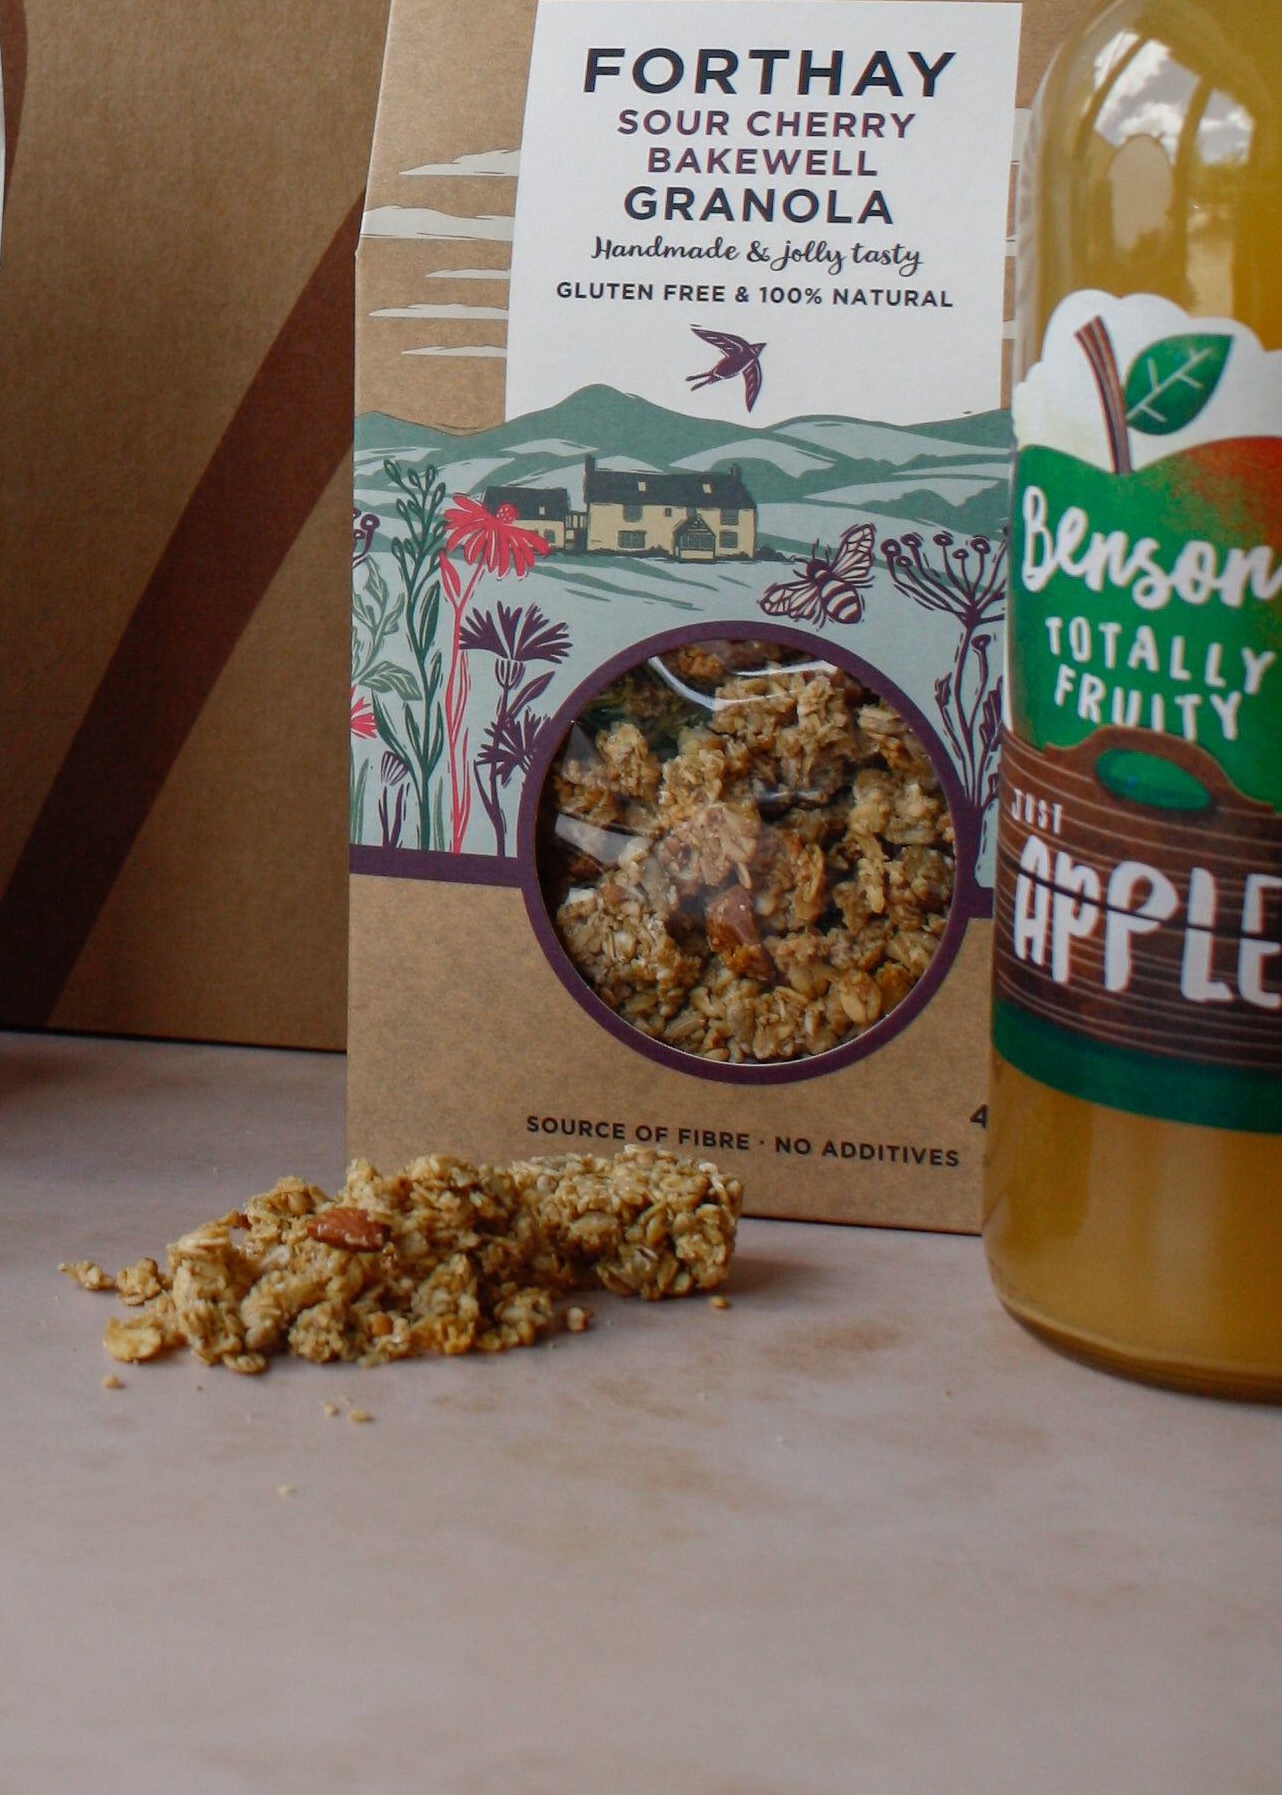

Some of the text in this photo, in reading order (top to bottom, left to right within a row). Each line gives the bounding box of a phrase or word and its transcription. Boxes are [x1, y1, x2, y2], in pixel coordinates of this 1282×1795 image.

[583, 47, 957, 98] FORTHAY
[617, 109, 916, 139] SOUR CHERRY
[647, 147, 879, 177] BAKEWELL
[624, 186, 894, 225] GRANOLA
[590, 235, 924, 277] Handmade & jolly tasty
[556, 281, 953, 308] GLUTEN FREE & 100% NATURAL
[1022, 485, 1282, 611] Benson
[1045, 616, 1277, 695] TOTALLY
[1054, 663, 1242, 742] FRUITY
[1011, 787, 1063, 835] JUST
[1013, 834, 1282, 1010] APPLE
[526, 1115, 960, 1168] SOURCE OF FIBRE NO ADDITIVES
